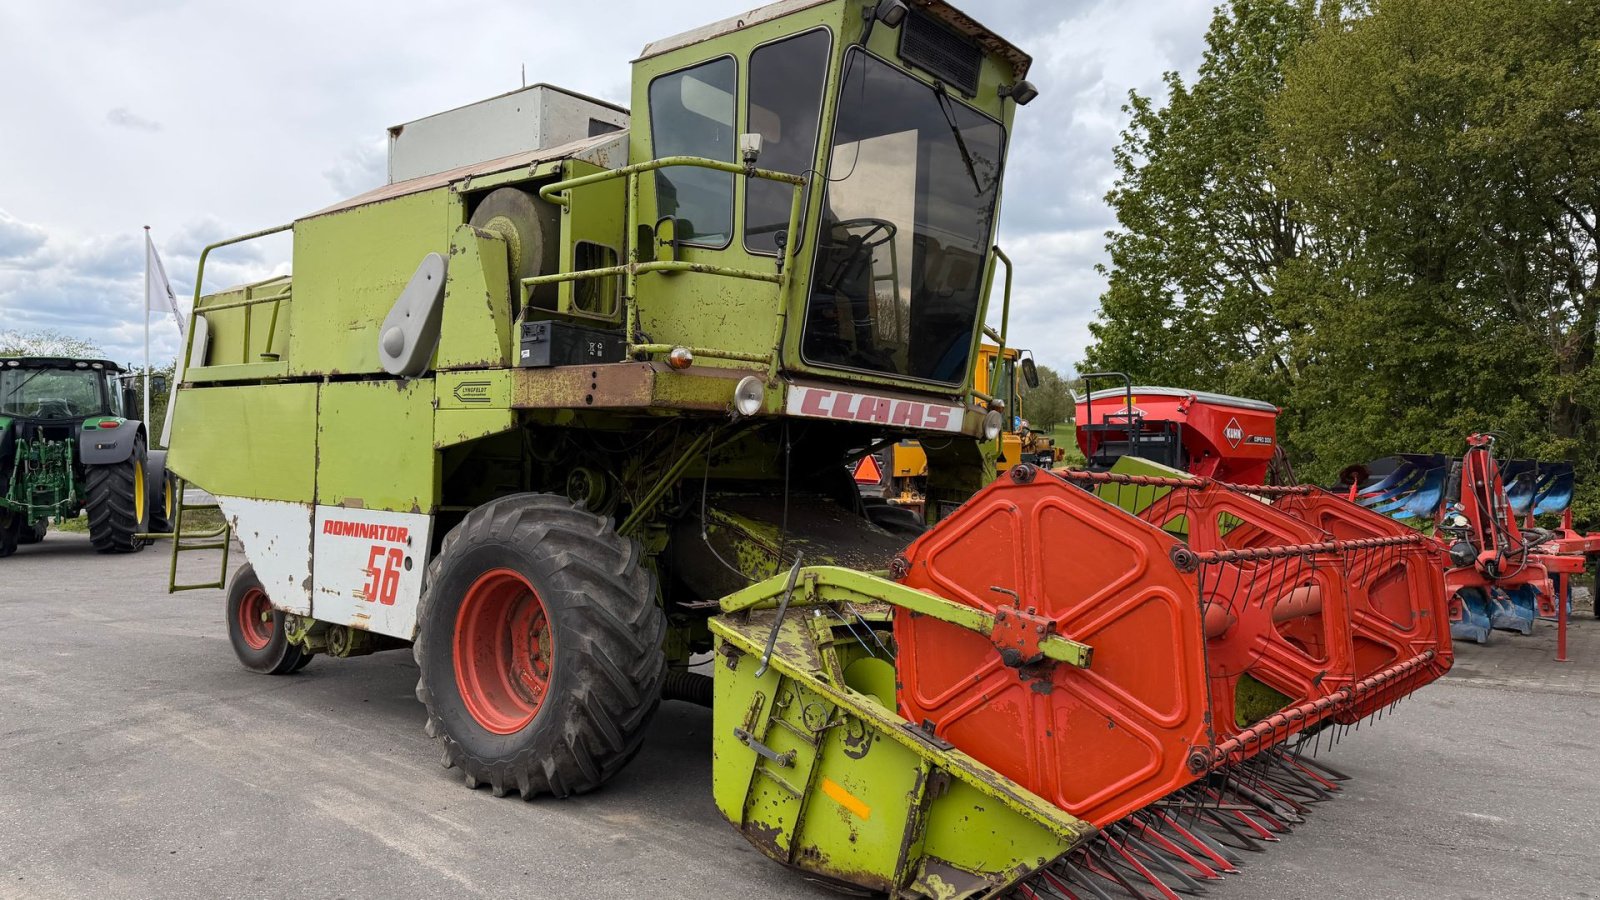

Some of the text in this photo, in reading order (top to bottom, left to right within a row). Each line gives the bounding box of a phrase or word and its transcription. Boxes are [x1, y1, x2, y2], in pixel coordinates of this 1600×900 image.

[800, 389, 951, 429] CLAAS
[1226, 428, 1241, 438] KUHN
[323, 520, 408, 543] DOMINATOR
[363, 545, 404, 606] 56
